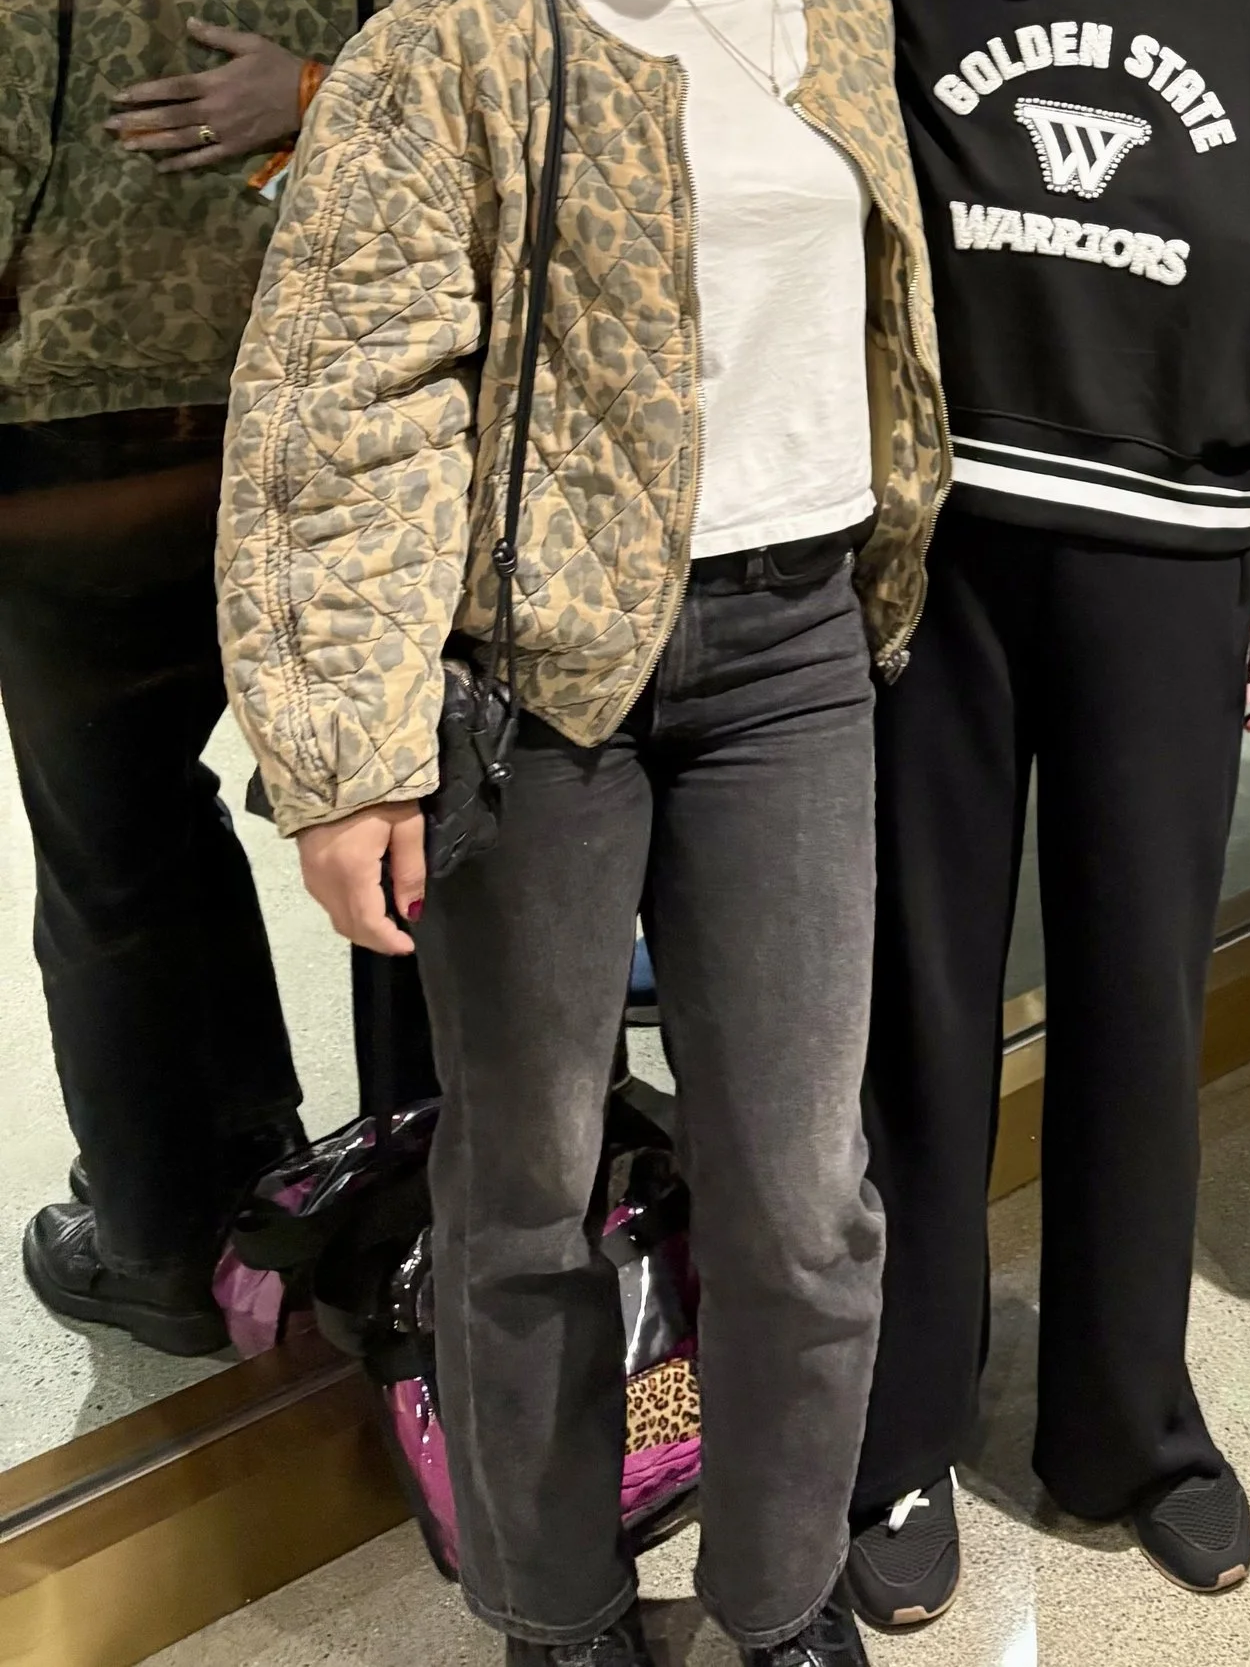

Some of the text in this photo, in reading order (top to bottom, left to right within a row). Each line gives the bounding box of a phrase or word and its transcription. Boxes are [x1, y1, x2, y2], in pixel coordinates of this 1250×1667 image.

[932, 20, 1238, 154] GOLDEN STATE
[949, 200, 1191, 286] WARRIORS
